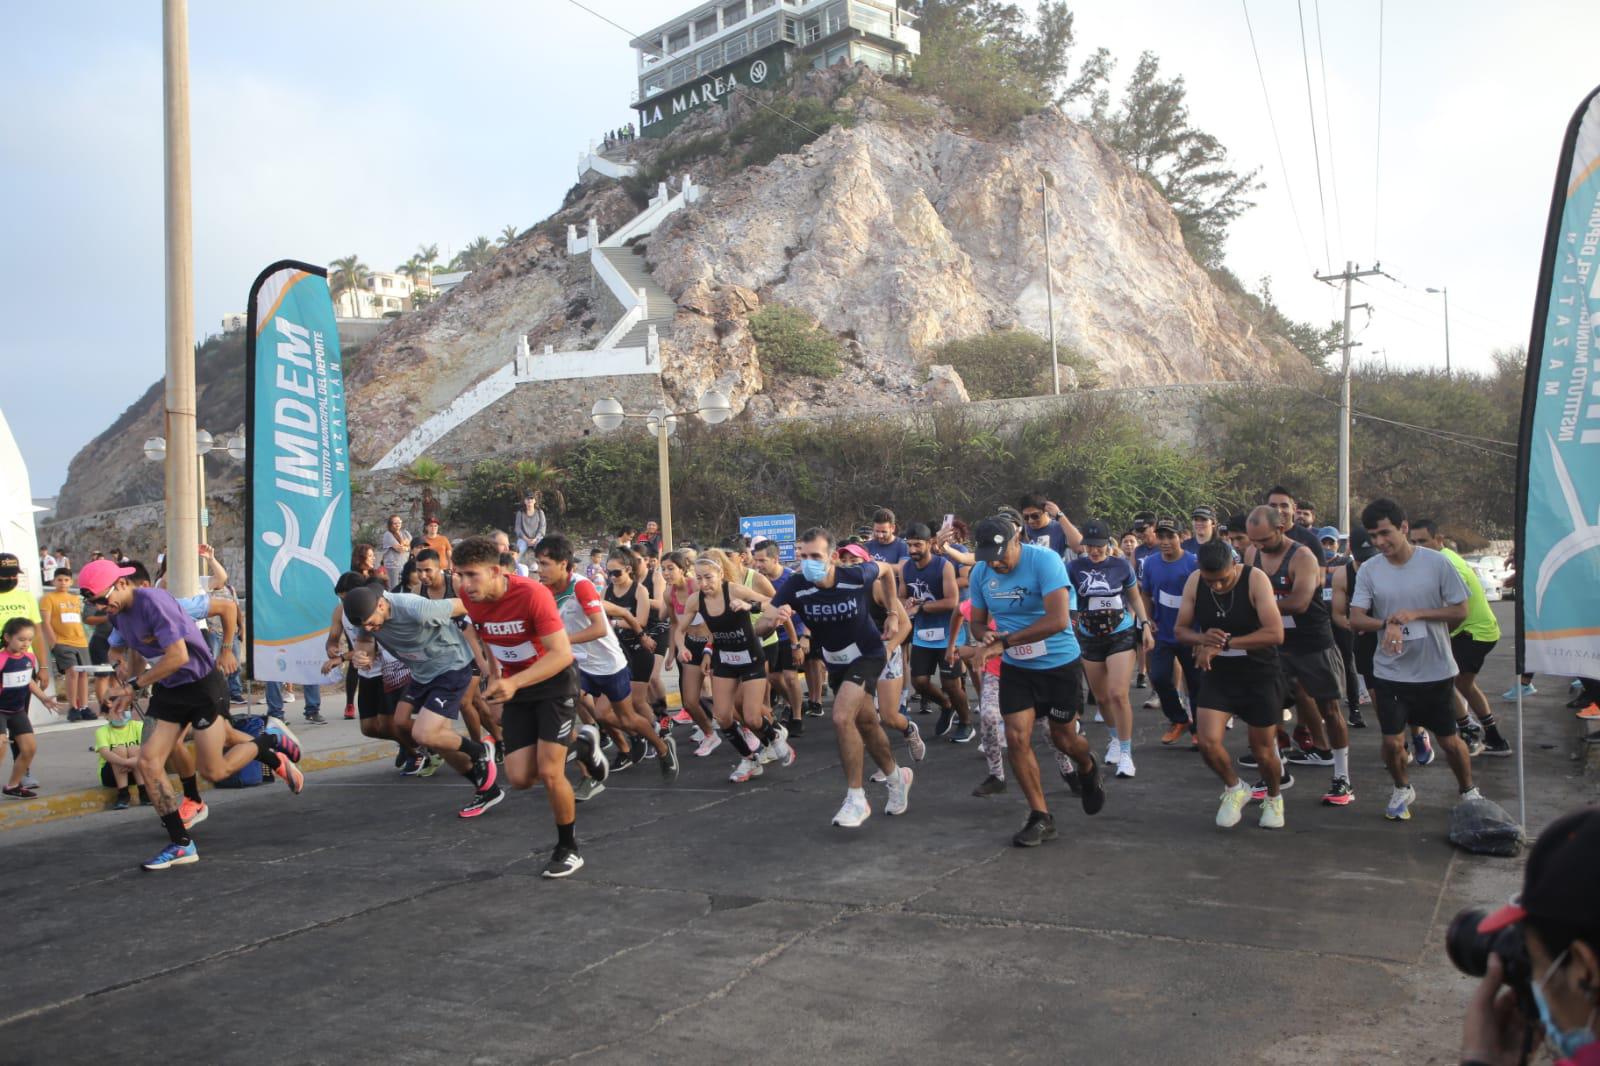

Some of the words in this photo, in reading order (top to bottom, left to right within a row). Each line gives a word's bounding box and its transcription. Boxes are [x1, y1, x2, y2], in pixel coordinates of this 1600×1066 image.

[642, 105, 664, 127] LA
[672, 72, 737, 115] MAREA
[313, 330, 326, 376] DEPORTE
[317, 377, 328, 395] DEL
[274, 316, 320, 497] IMDEM
[318, 397, 330, 450] MUNICIPAL
[322, 449, 333, 497] INSTITUTO
[804, 597, 857, 615] LEGION
[1100, 600, 1112, 608] 56
[483, 620, 526, 635] TECATE
[502, 649, 518, 658] 35
[1013, 645, 1032, 656] 108
